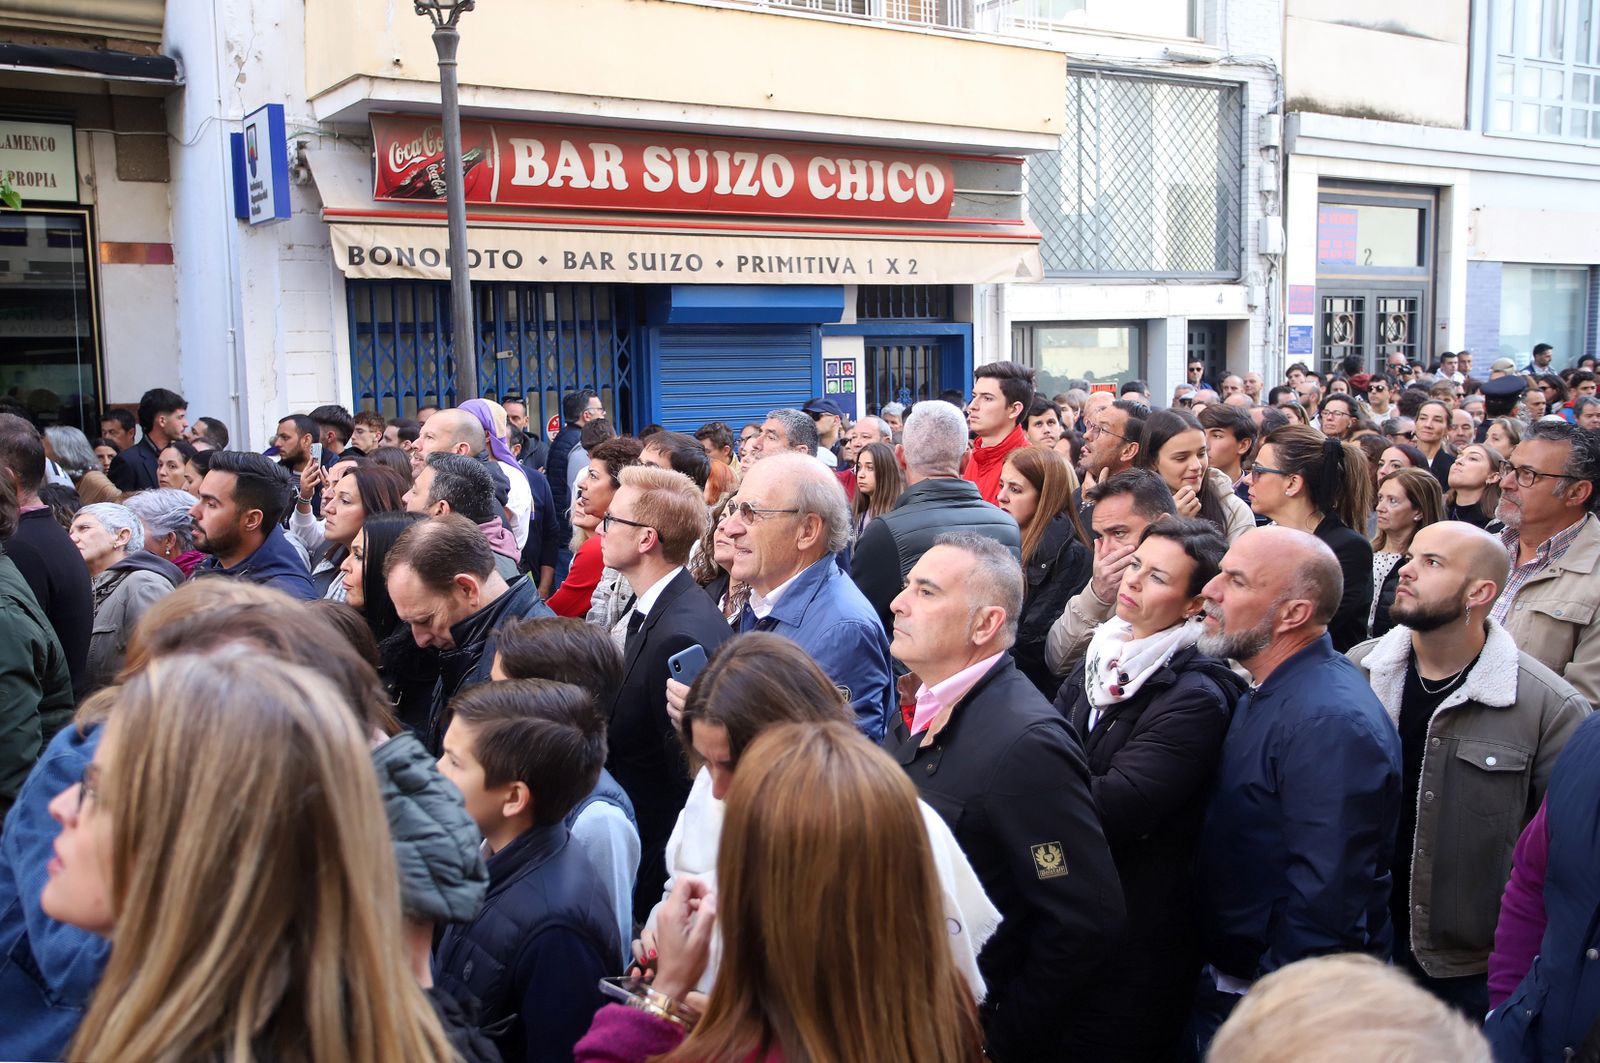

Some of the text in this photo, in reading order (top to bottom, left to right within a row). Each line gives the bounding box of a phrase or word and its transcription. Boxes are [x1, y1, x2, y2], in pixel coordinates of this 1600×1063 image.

[508, 137, 945, 205] BAR SUIZO CHICO
[563, 250, 616, 271] BAR
[628, 252, 704, 273] SUIZO
[736, 255, 856, 275] PRIMITIVA
[868, 258, 874, 275] 1
[886, 257, 900, 275] X
[908, 258, 918, 275] 2
[1364, 248, 1373, 266] 2
